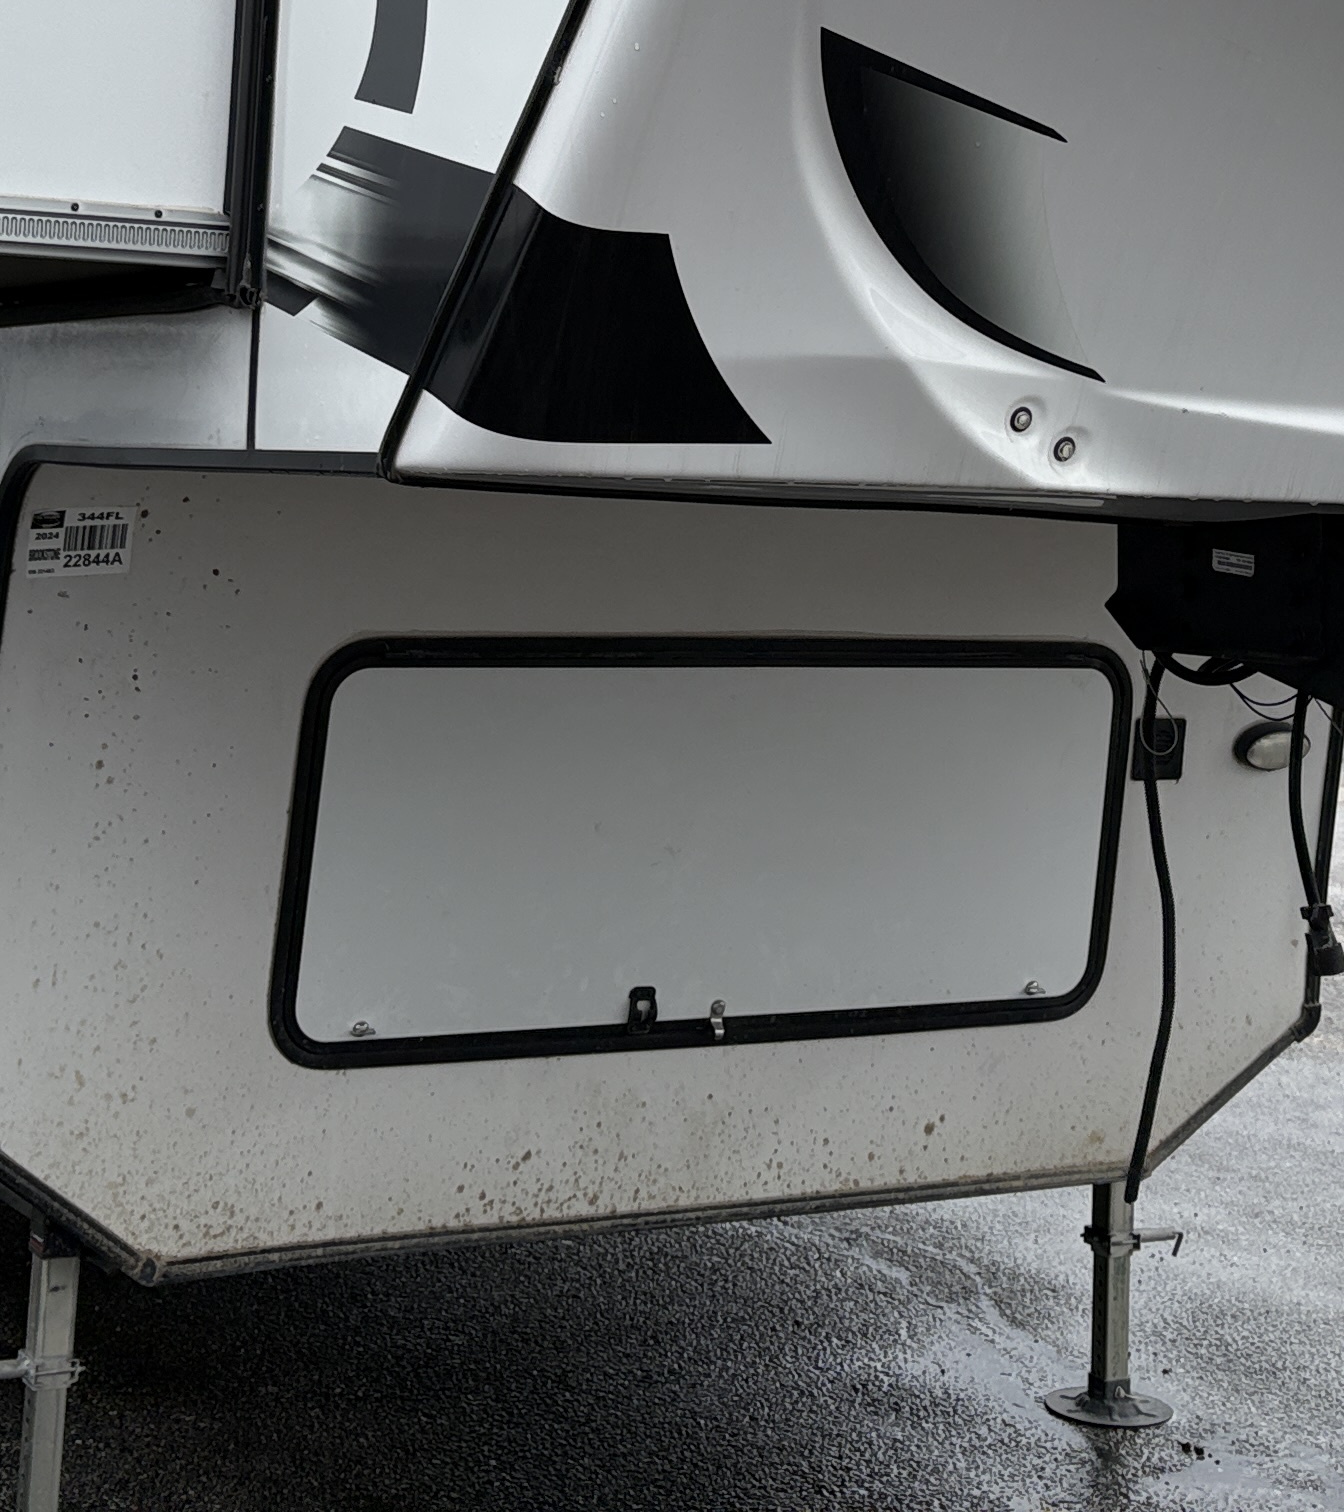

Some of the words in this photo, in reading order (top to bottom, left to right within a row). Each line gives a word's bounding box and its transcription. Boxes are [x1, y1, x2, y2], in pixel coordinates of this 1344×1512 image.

[77, 511, 124, 522] 344FL
[35, 531, 60, 541] 2024
[63, 551, 123, 568] 22844A
